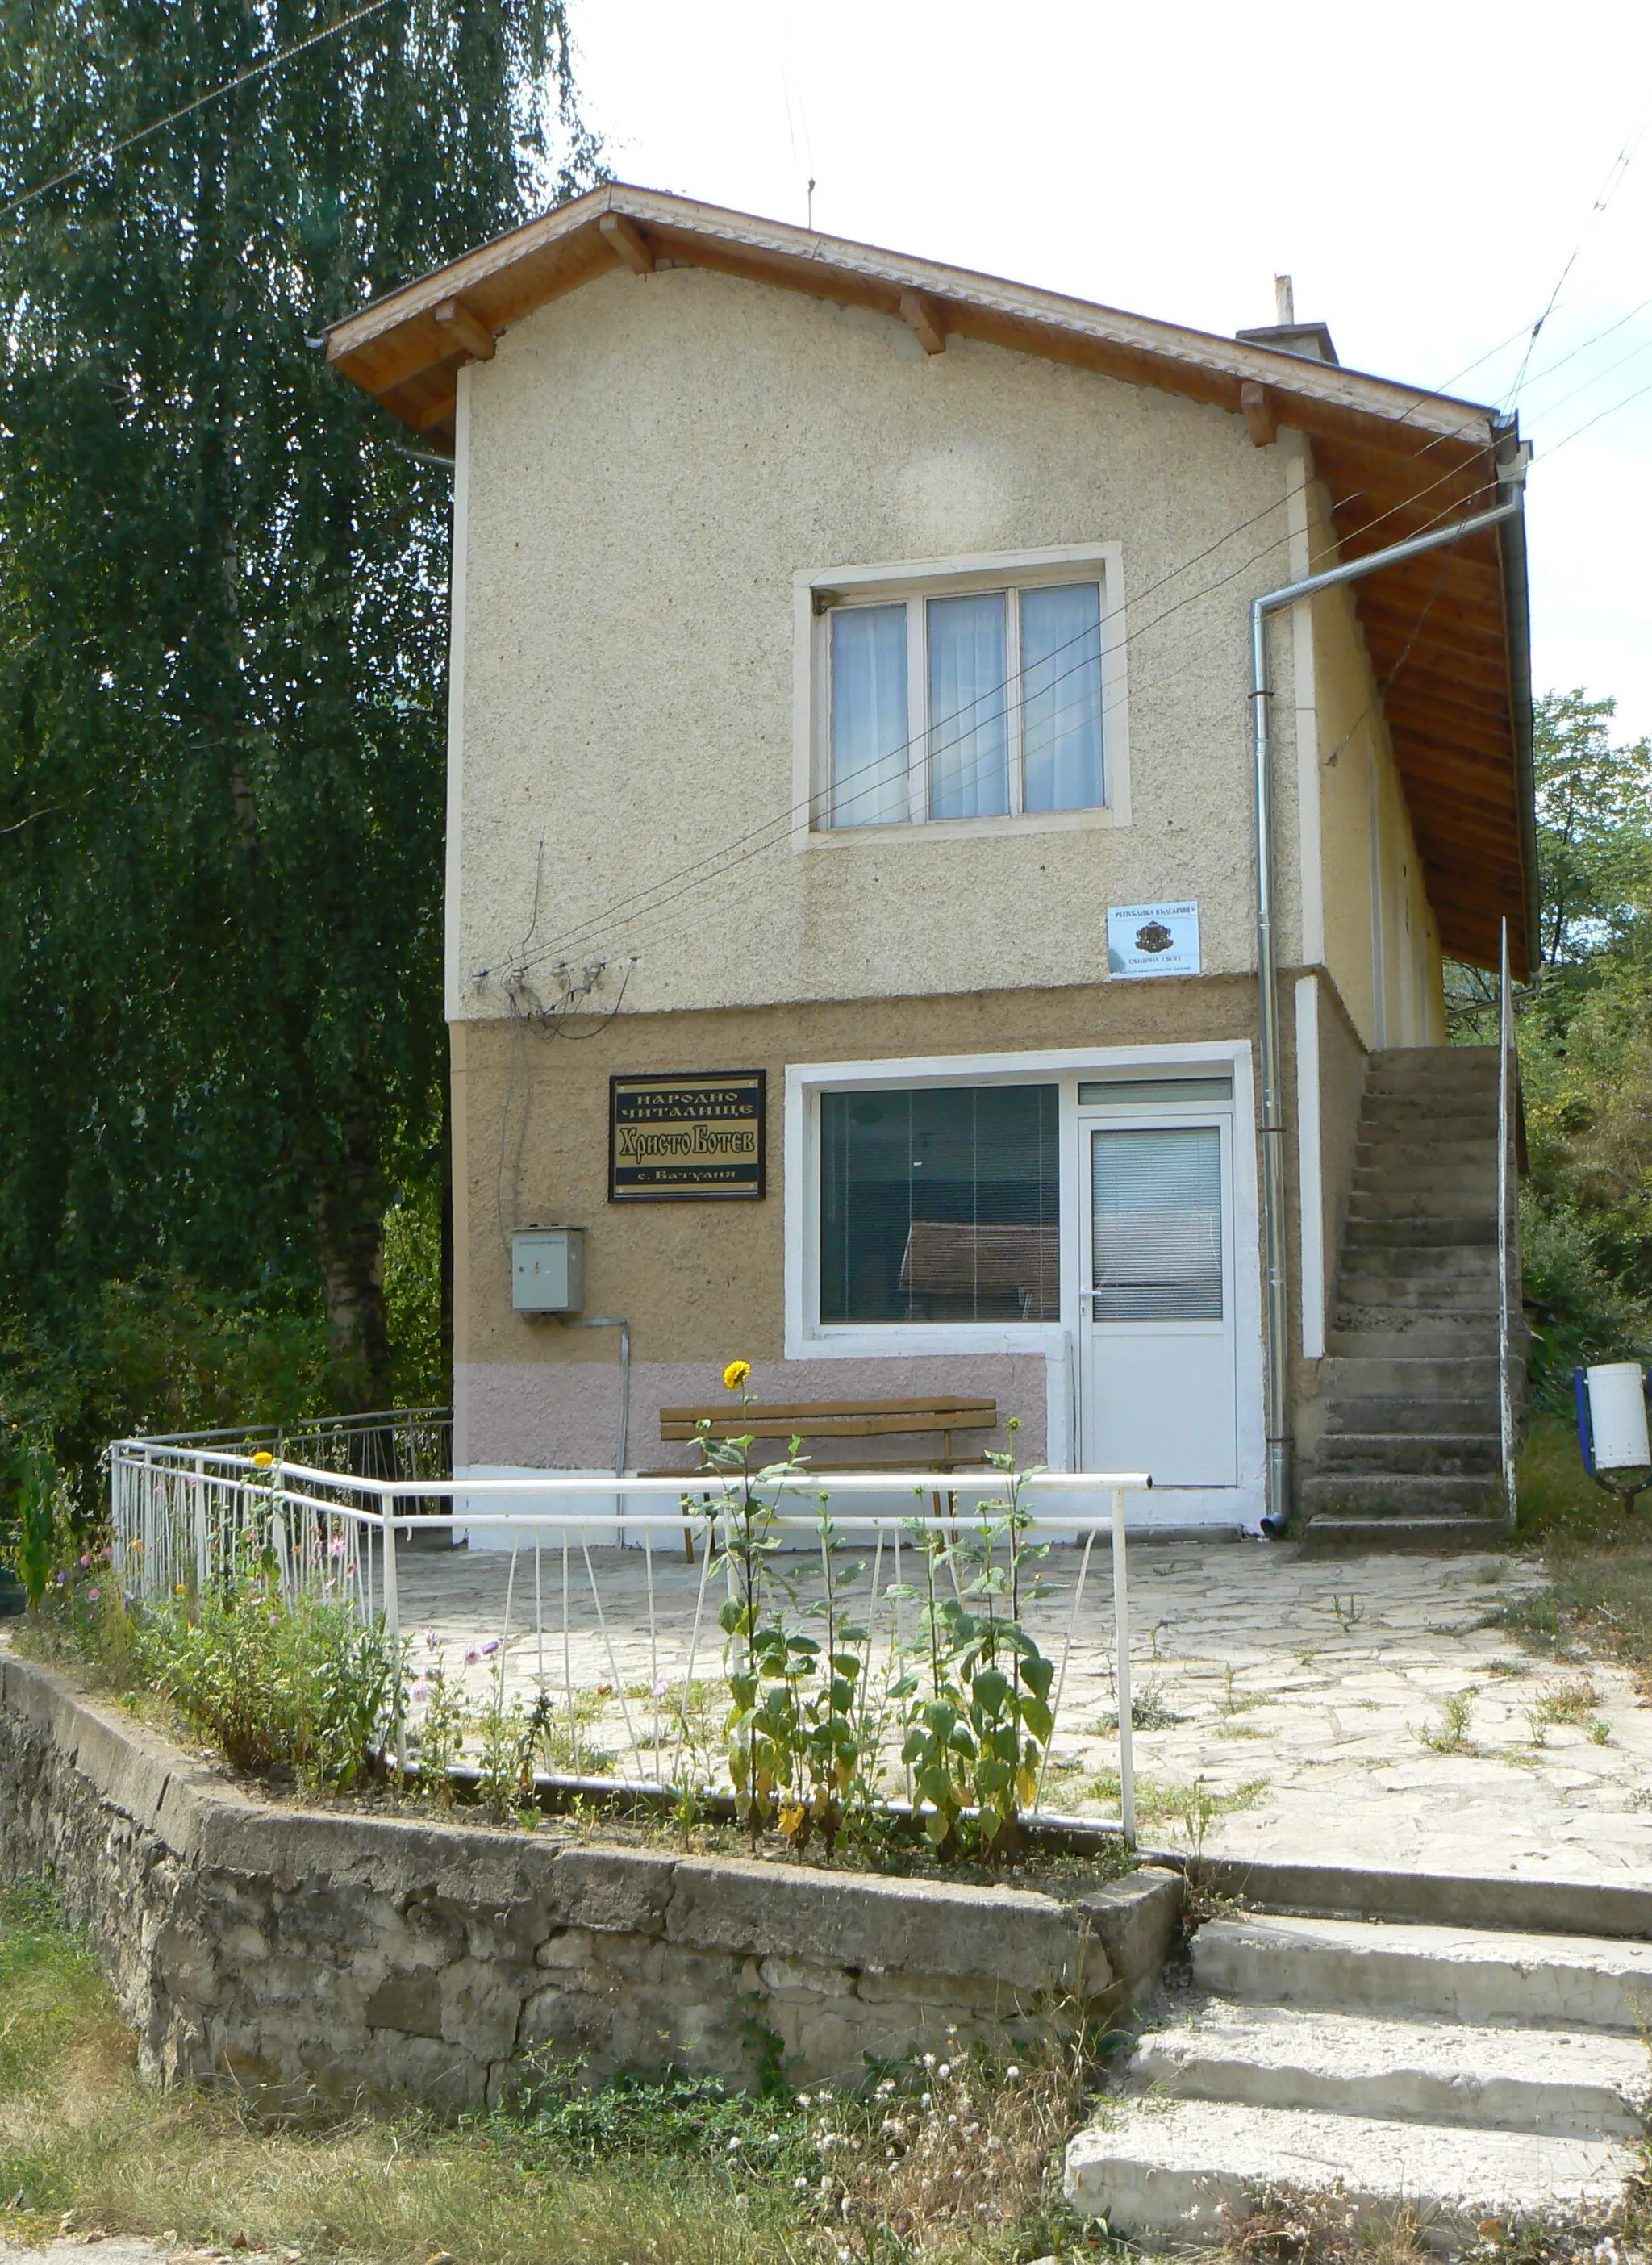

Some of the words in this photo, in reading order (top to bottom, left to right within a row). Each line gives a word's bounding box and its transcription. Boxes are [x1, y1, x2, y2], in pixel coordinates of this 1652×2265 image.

[637, 1092, 738, 1105] НАРОДНО
[622, 1103, 754, 1118] ЧИТАЛИЩЕ
[620, 1127, 692, 1164] Христо
[692, 1125, 755, 1153] Ботев
[655, 1170, 736, 1181] Батулия
